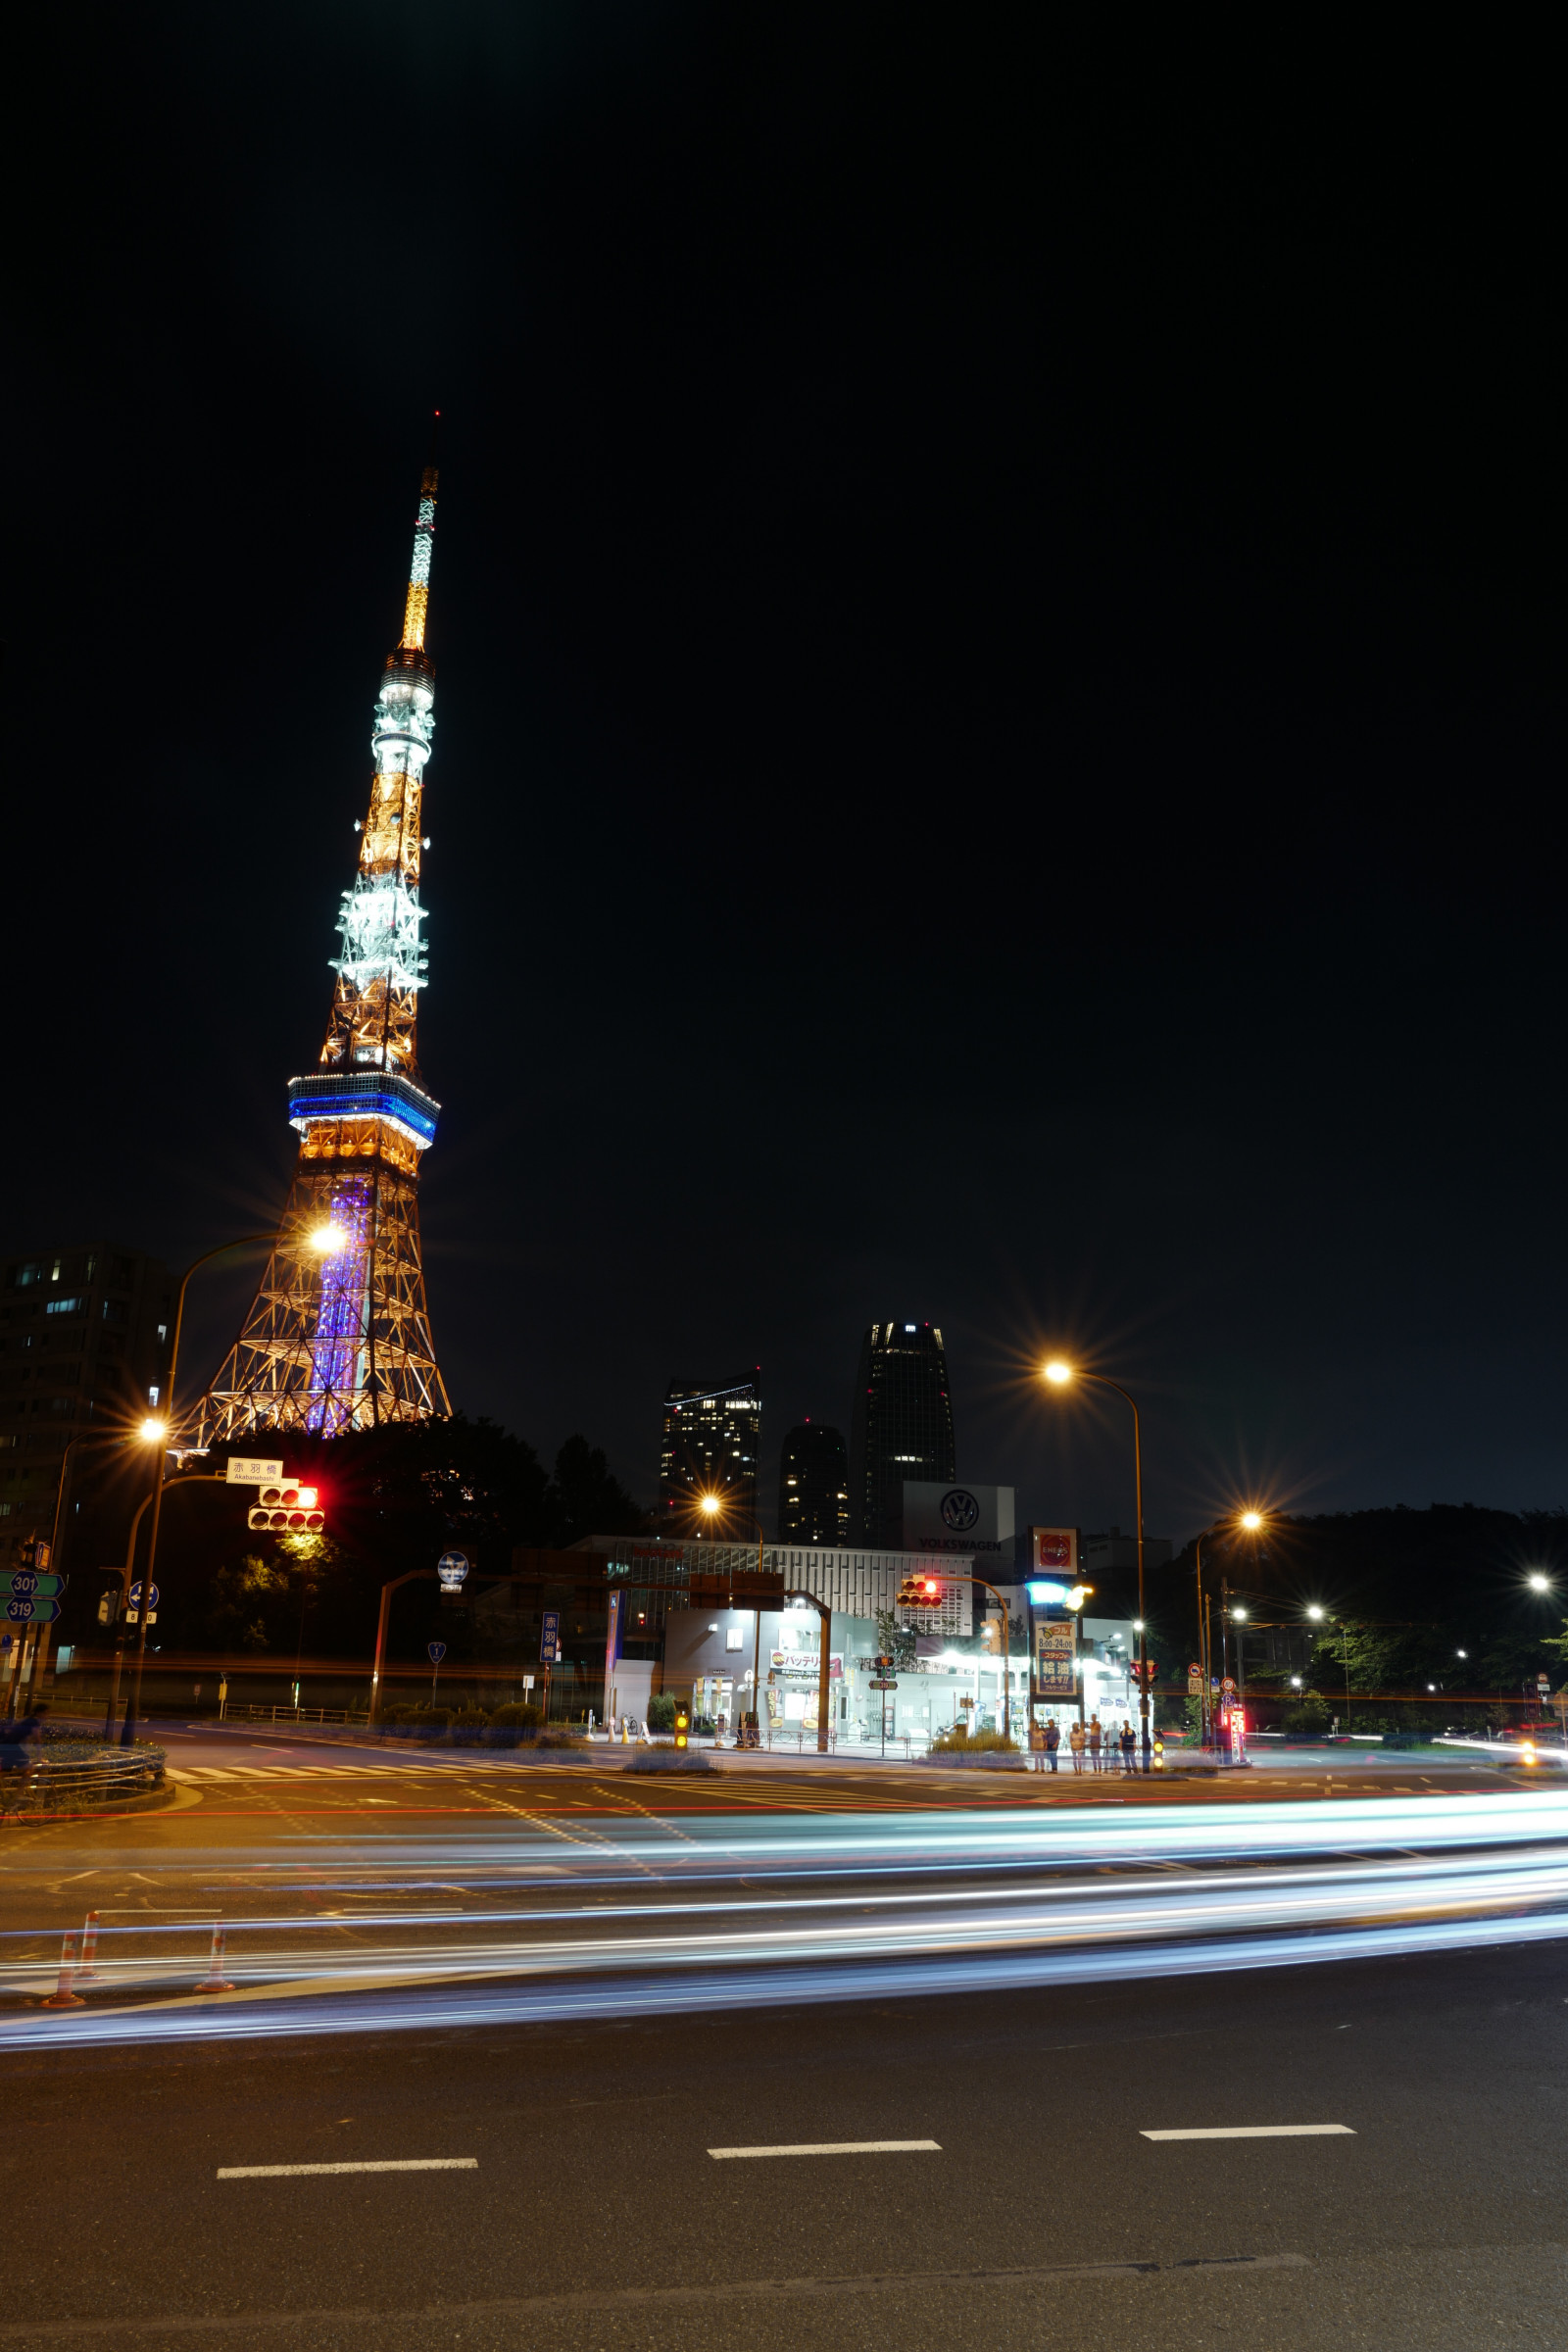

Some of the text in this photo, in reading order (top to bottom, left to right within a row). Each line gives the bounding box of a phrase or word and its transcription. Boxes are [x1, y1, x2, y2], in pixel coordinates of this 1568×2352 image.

[233, 1462, 276, 1475] 赤羽橋
[919, 1538, 1002, 1551] VOLKSWAGEN
[14, 1578, 35, 1592] 301
[10, 1602, 32, 1616] 319
[543, 1616, 557, 1658] 赤羽橋
[784, 1655, 821, 1667] バッテリ
[1042, 1661, 1070, 1675] 給油
